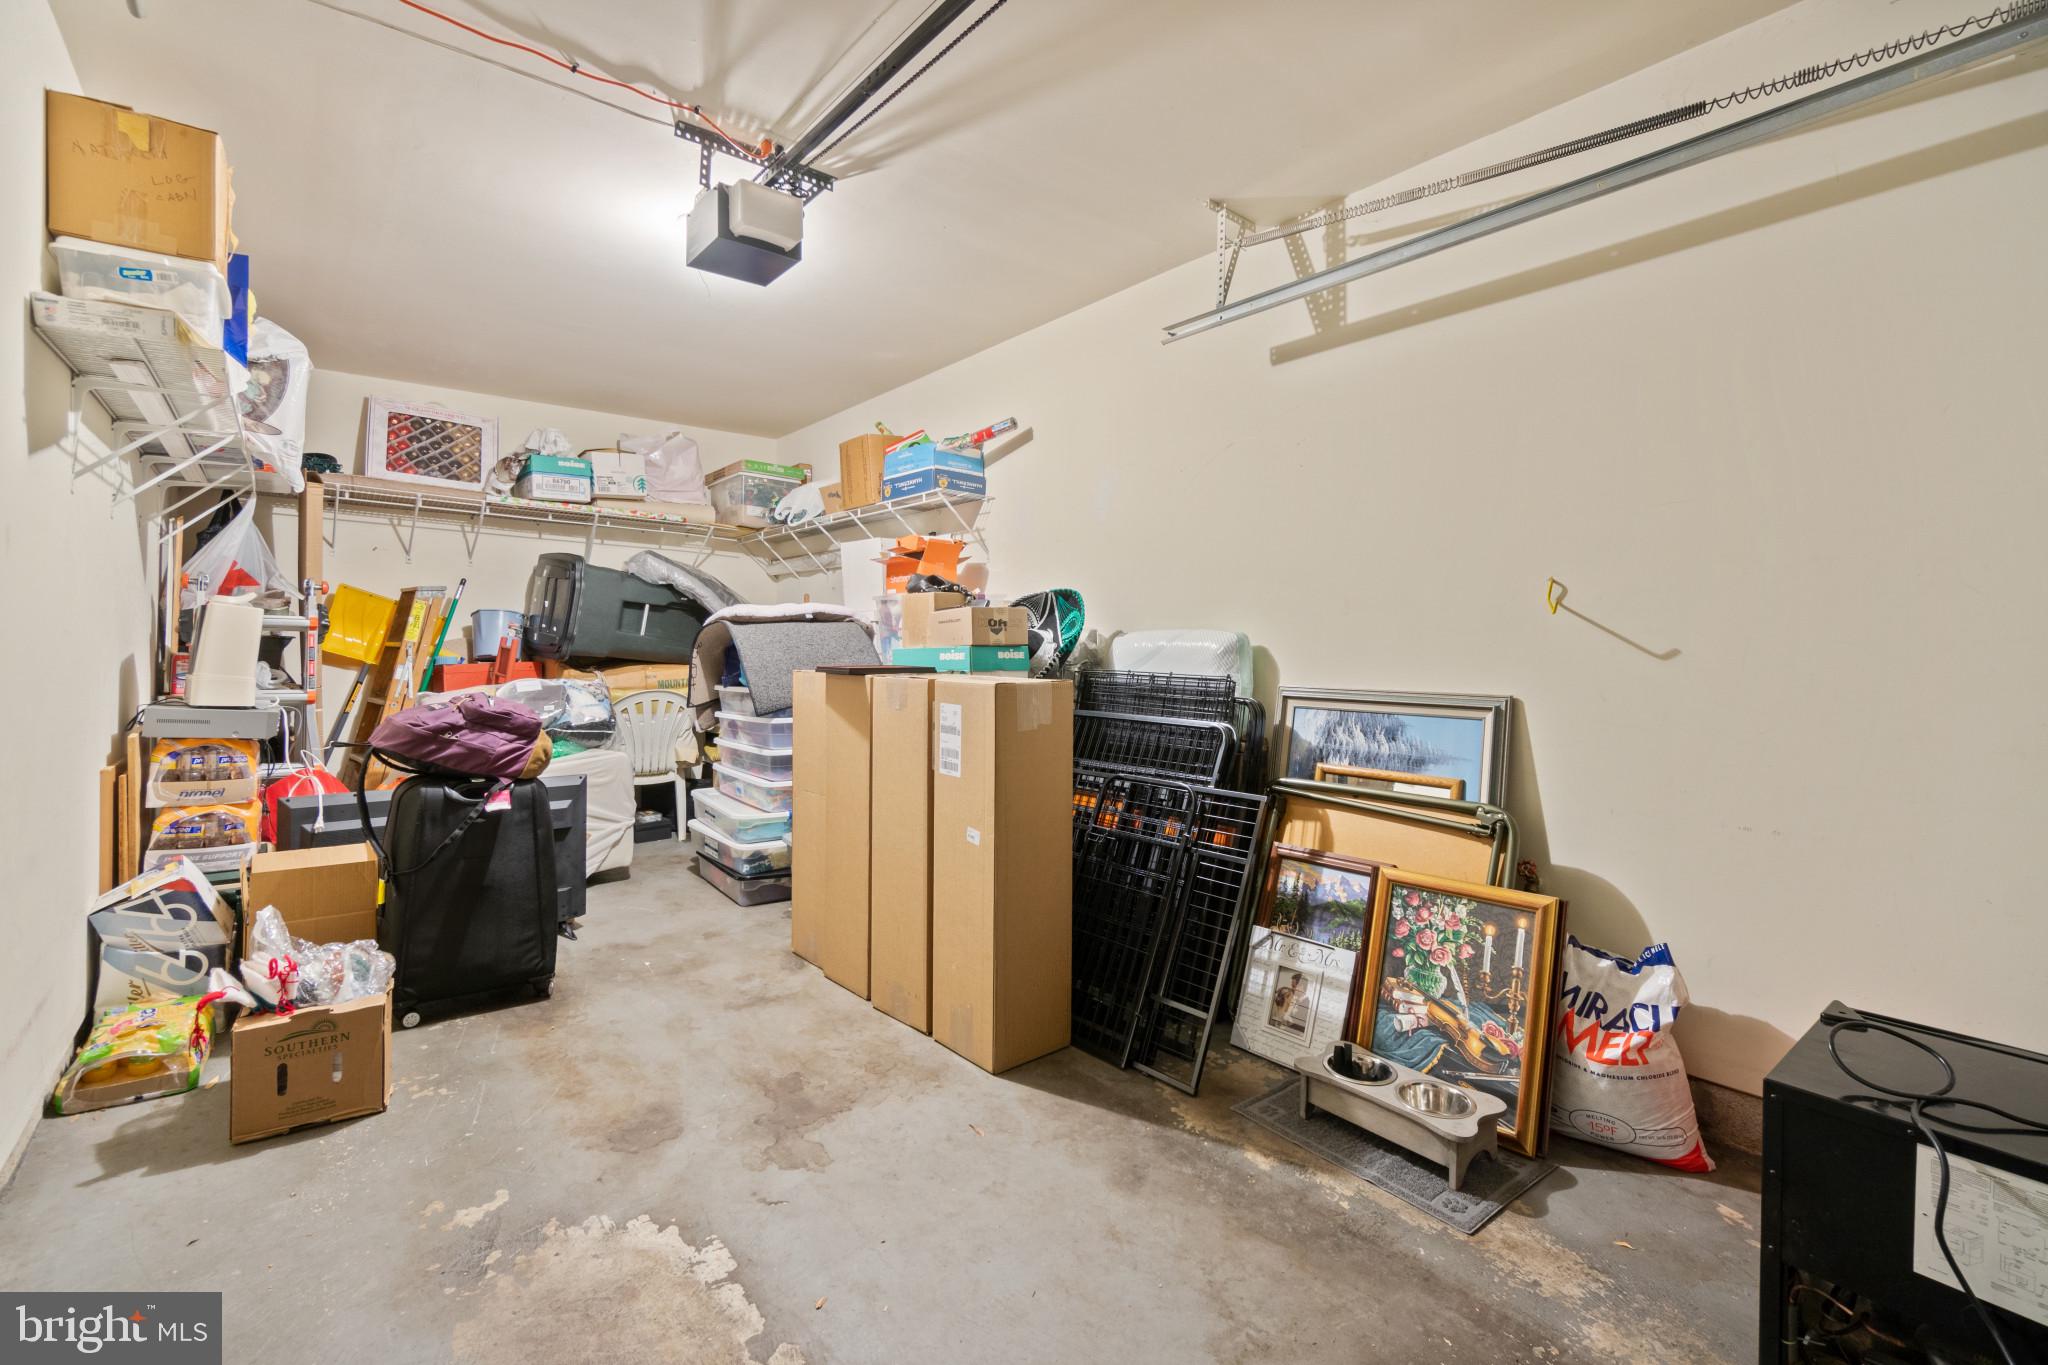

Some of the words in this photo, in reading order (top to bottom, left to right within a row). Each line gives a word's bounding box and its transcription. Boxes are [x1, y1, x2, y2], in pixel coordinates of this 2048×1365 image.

[1651, 943, 1665, 954] MELT
[1557, 1007, 1654, 1067] MELT
[264, 1031, 350, 1057] SOUTHERN
[278, 1044, 338, 1060] SPECIALTIES
[1590, 1070, 1634, 1080] MAGNESIUM
[1636, 1072, 1665, 1081] CHLORIDE
[1585, 1113, 1616, 1126] MELTING
[1589, 1131, 1615, 1141] POWER
